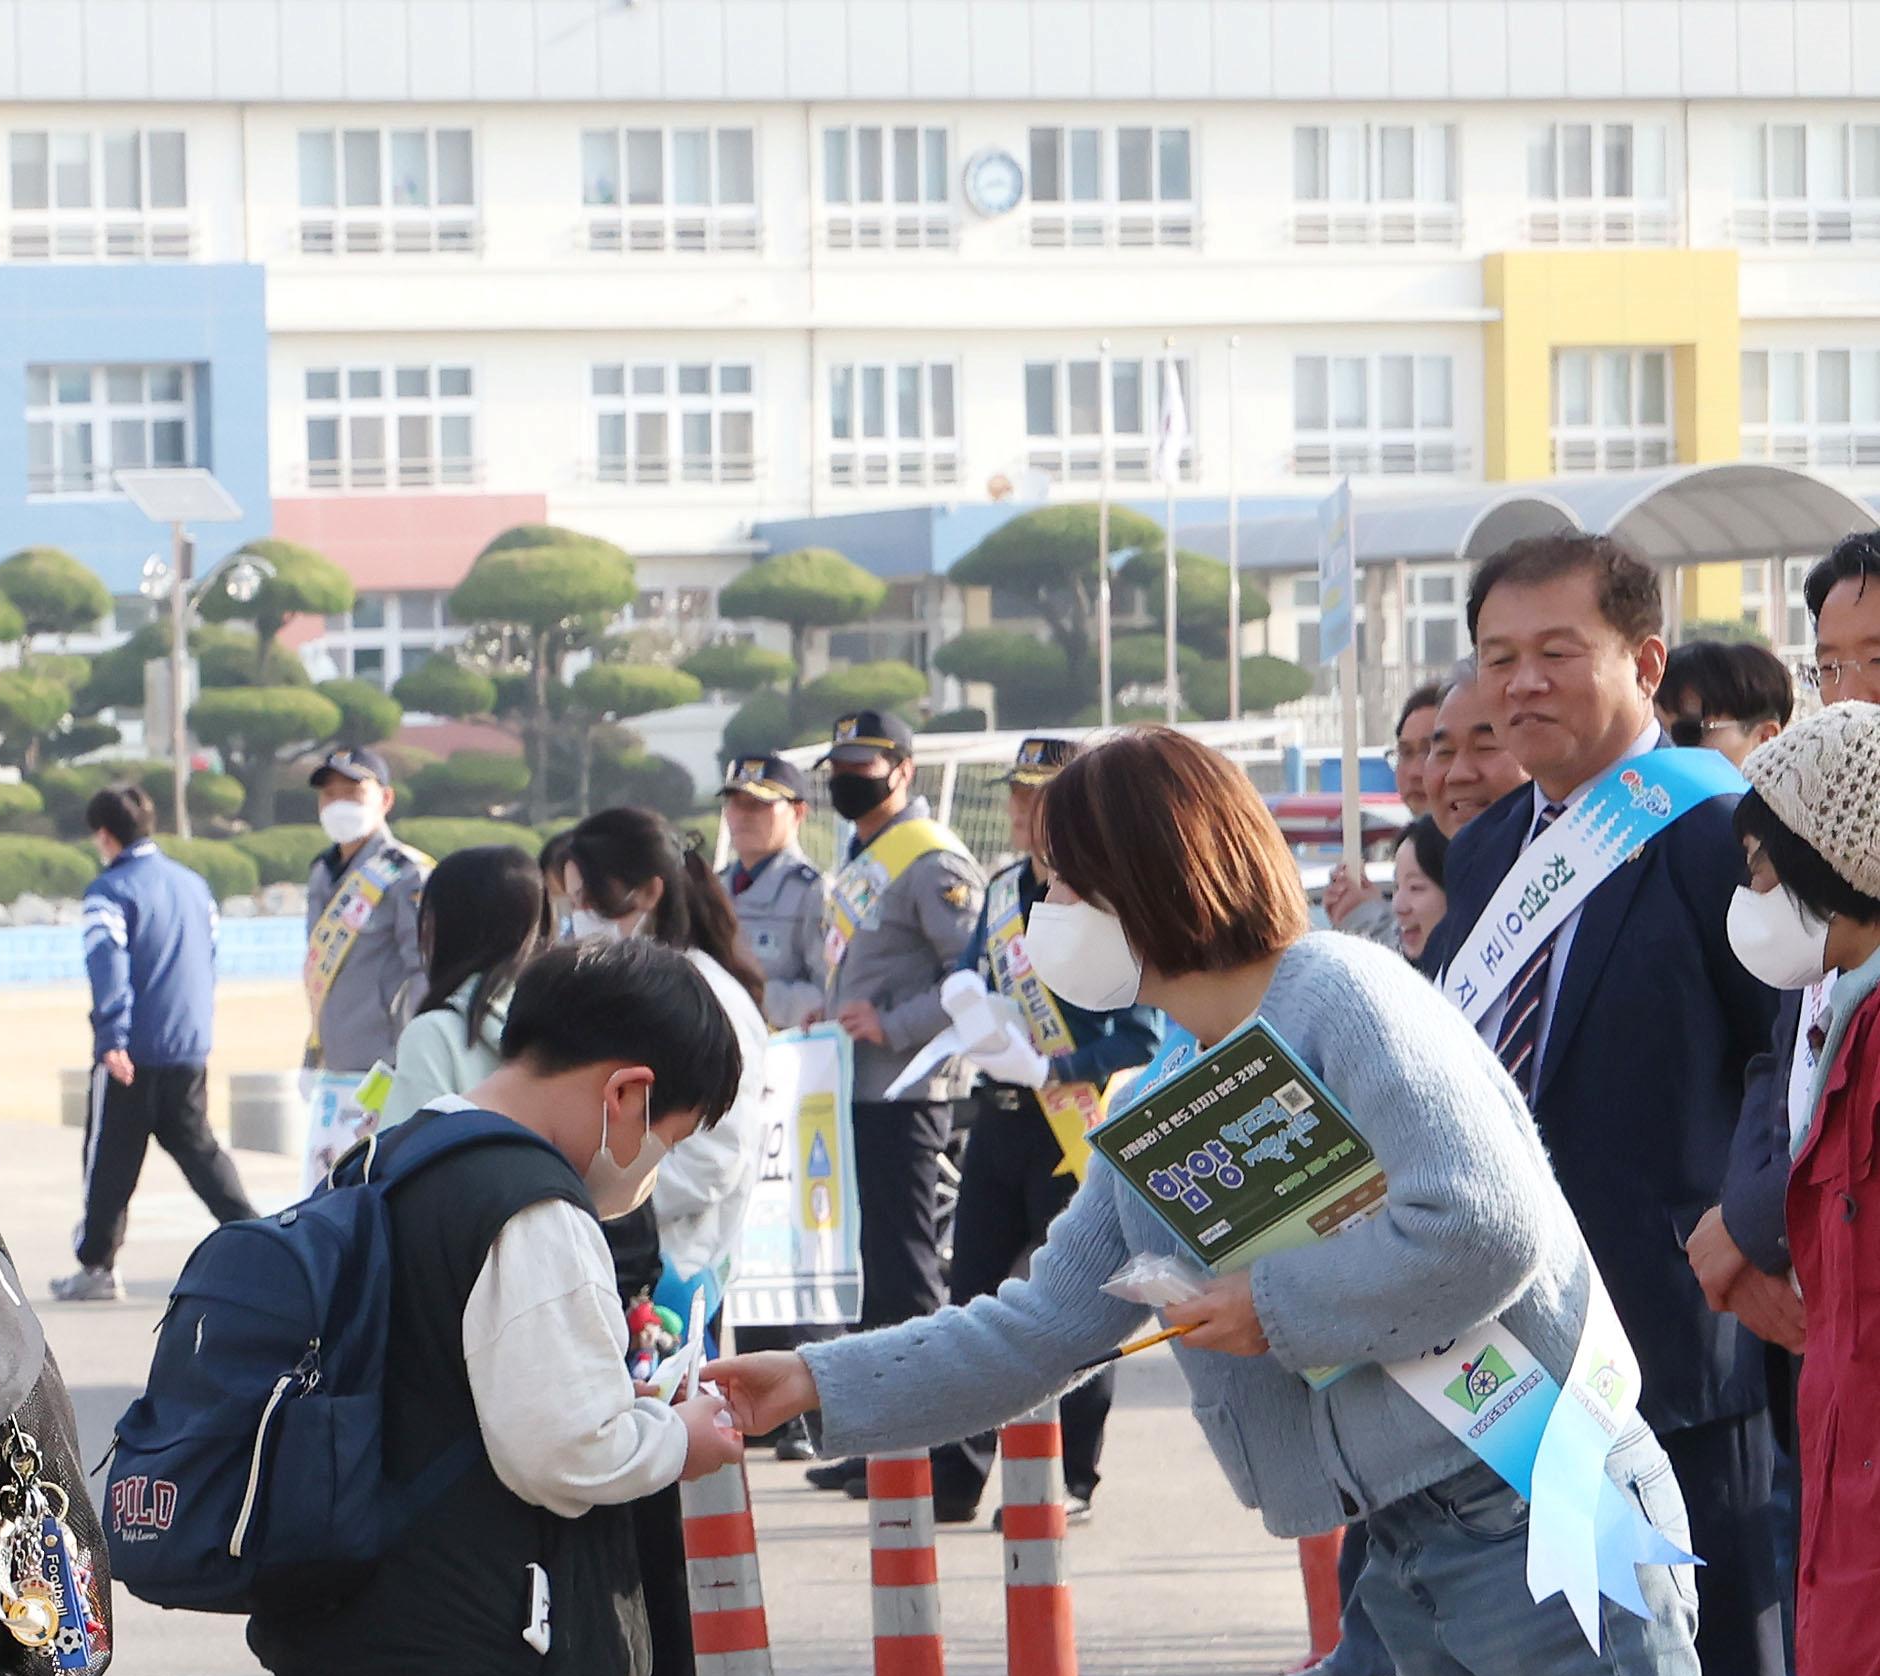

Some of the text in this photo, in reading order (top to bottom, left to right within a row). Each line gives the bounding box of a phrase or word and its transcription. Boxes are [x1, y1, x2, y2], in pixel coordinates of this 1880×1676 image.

[1146, 1139, 1245, 1215] 함양
[111, 1475, 178, 1533] POLO
[47, 1554, 69, 1617] Football
